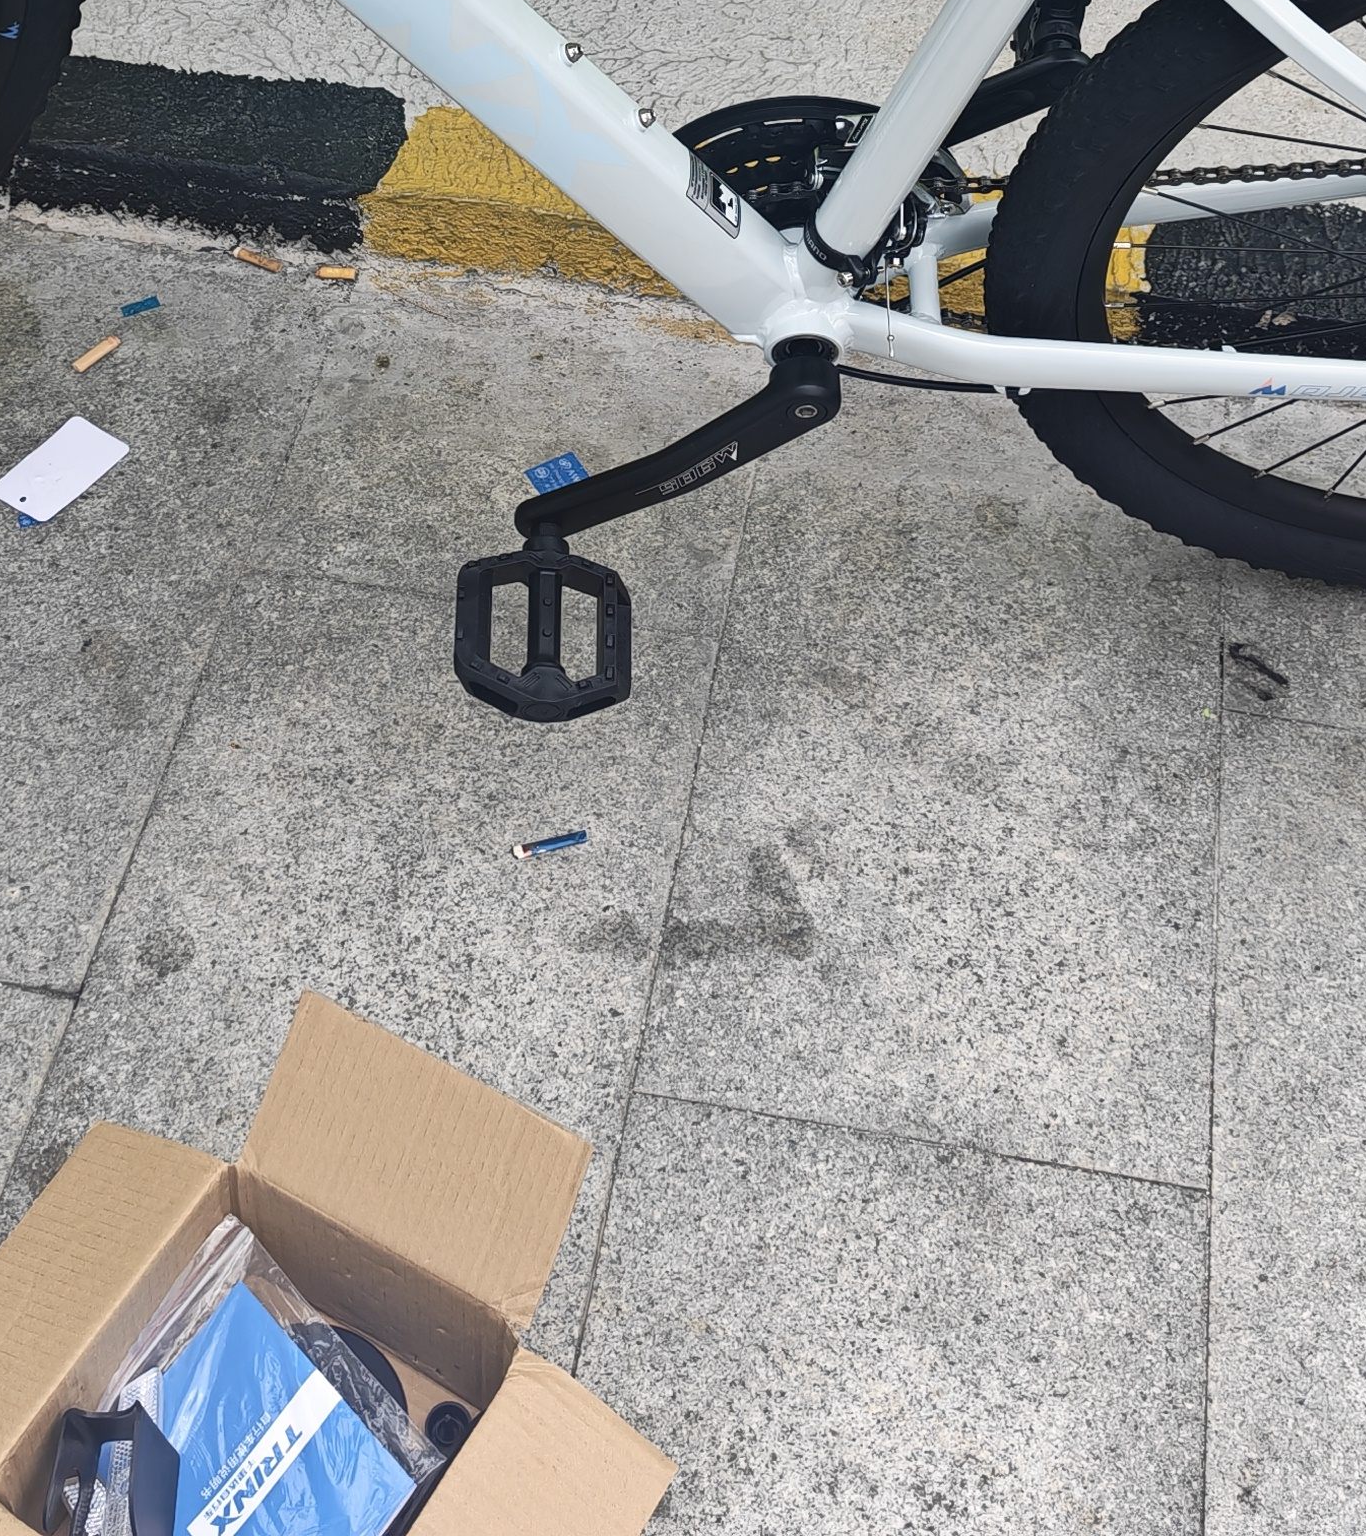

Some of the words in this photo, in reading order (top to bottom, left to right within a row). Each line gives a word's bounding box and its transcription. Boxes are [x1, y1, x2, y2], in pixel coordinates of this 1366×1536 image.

[199, 1411, 272, 1500] 自行车使用说明书
[209, 1423, 304, 1536] TRINX
